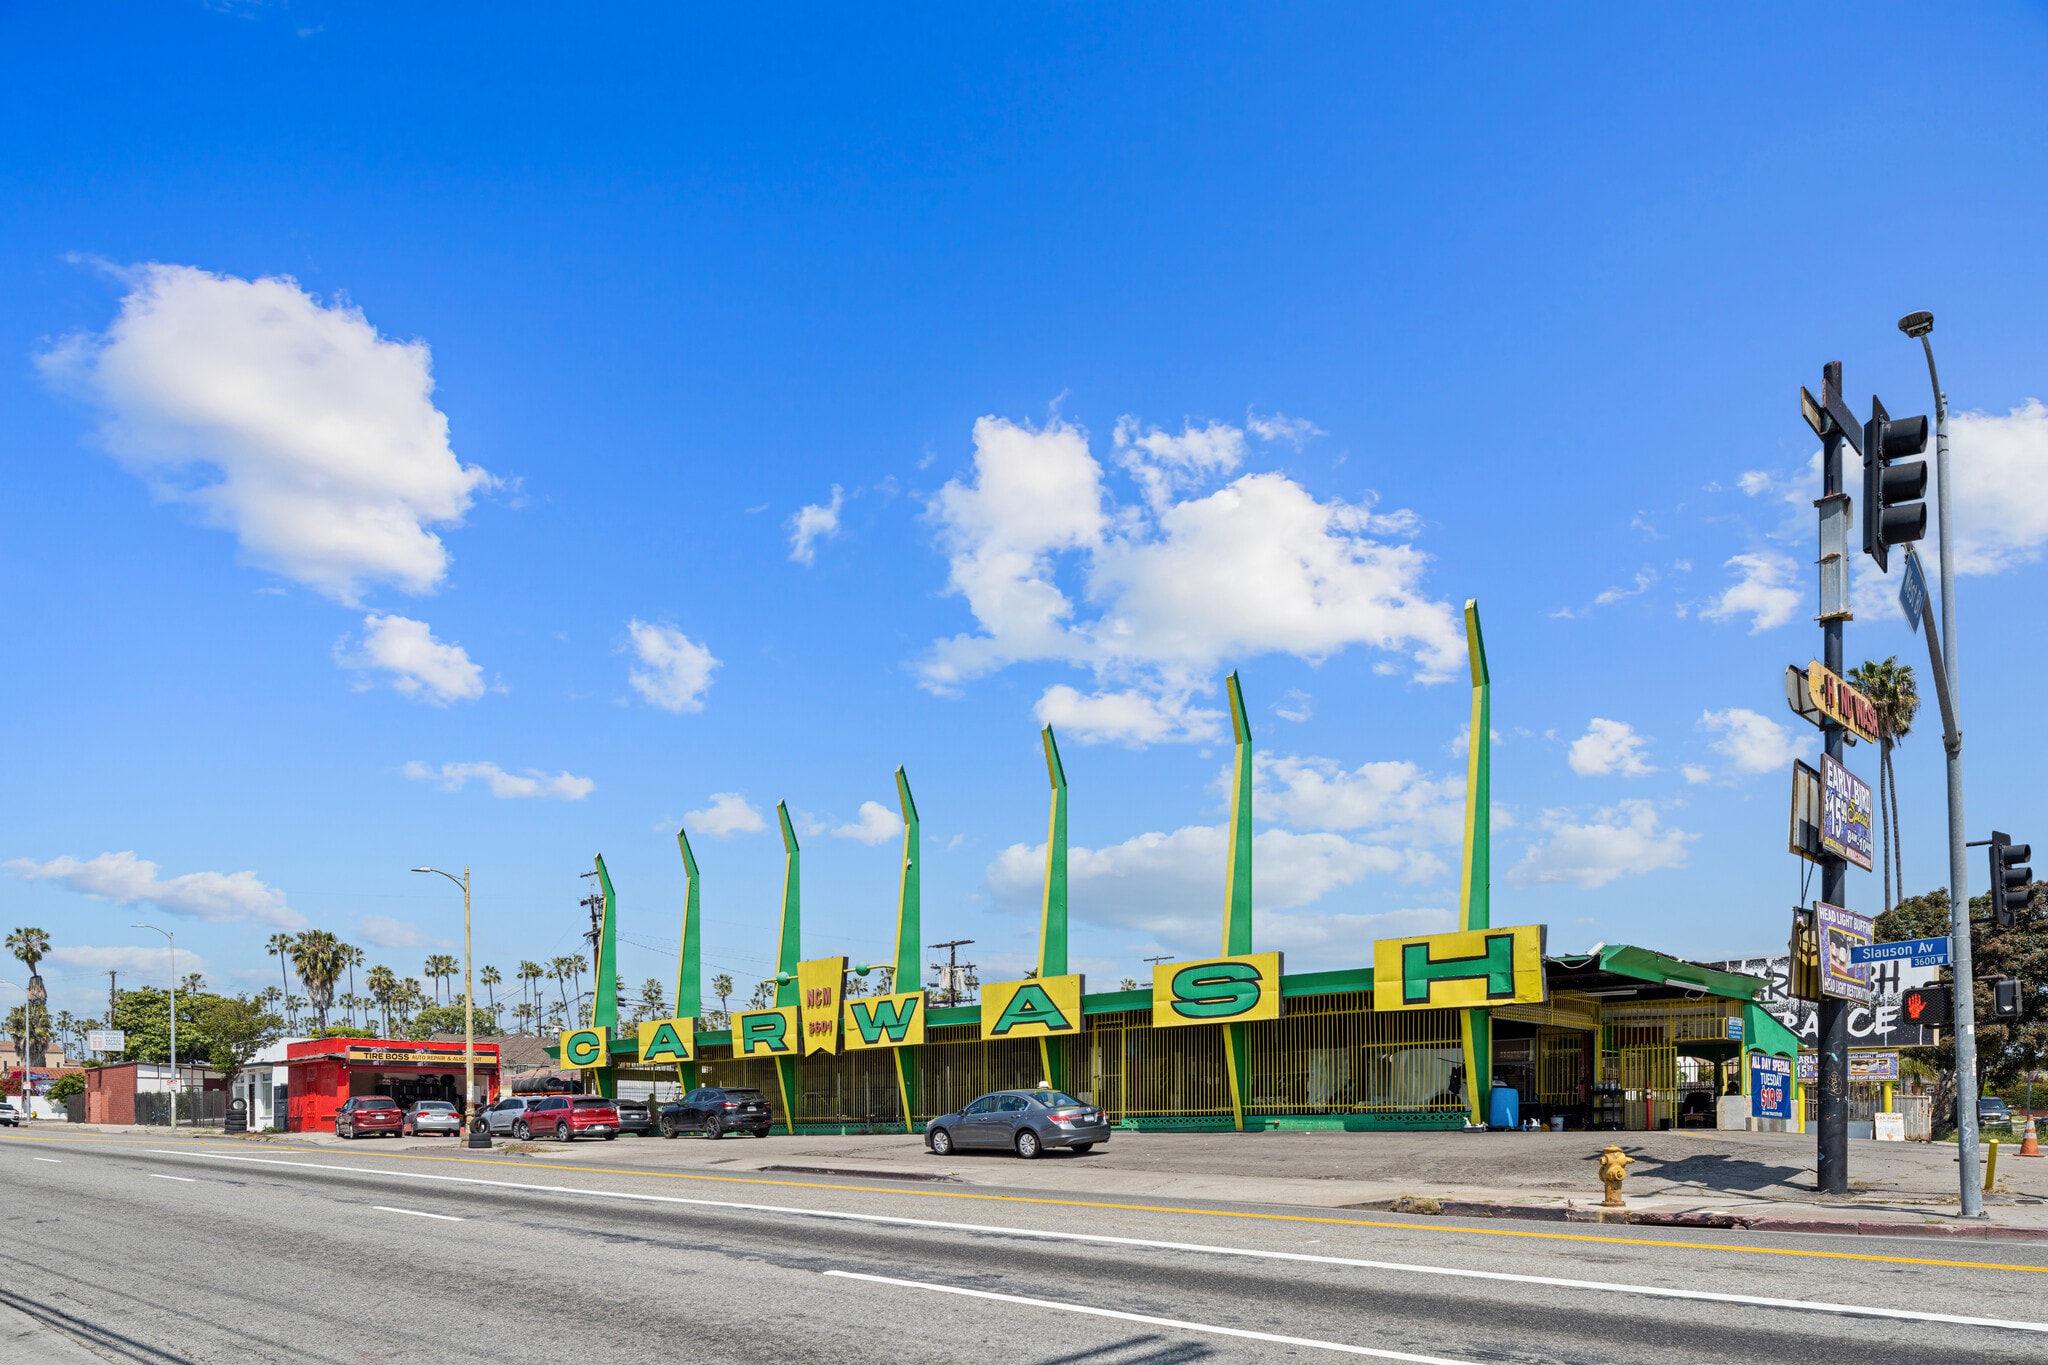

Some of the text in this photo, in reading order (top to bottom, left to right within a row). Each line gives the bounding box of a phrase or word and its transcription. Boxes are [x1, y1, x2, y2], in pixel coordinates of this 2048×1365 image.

[1851, 695, 1879, 739] WASH
[1827, 760, 1871, 814] EARLY BIRD
[1847, 797, 1871, 829] Special
[1820, 907, 1875, 936] HEAD LIGHT BUFFING
[1862, 942, 1934, 960] Slauson Av
[1914, 955, 1944, 966] 3600 W
[806, 986, 832, 1007] NCM
[1824, 977, 1870, 1001] HEAD LIGHT RESTORATION
[808, 1020, 832, 1035] 3601
[364, 1052, 384, 1060] TIRE
[1751, 1055, 1790, 1073] ALL DAY SPECIAL
[1797, 1055, 1818, 1064] ARLY
[1760, 1072, 1782, 1087] TUESDAY
